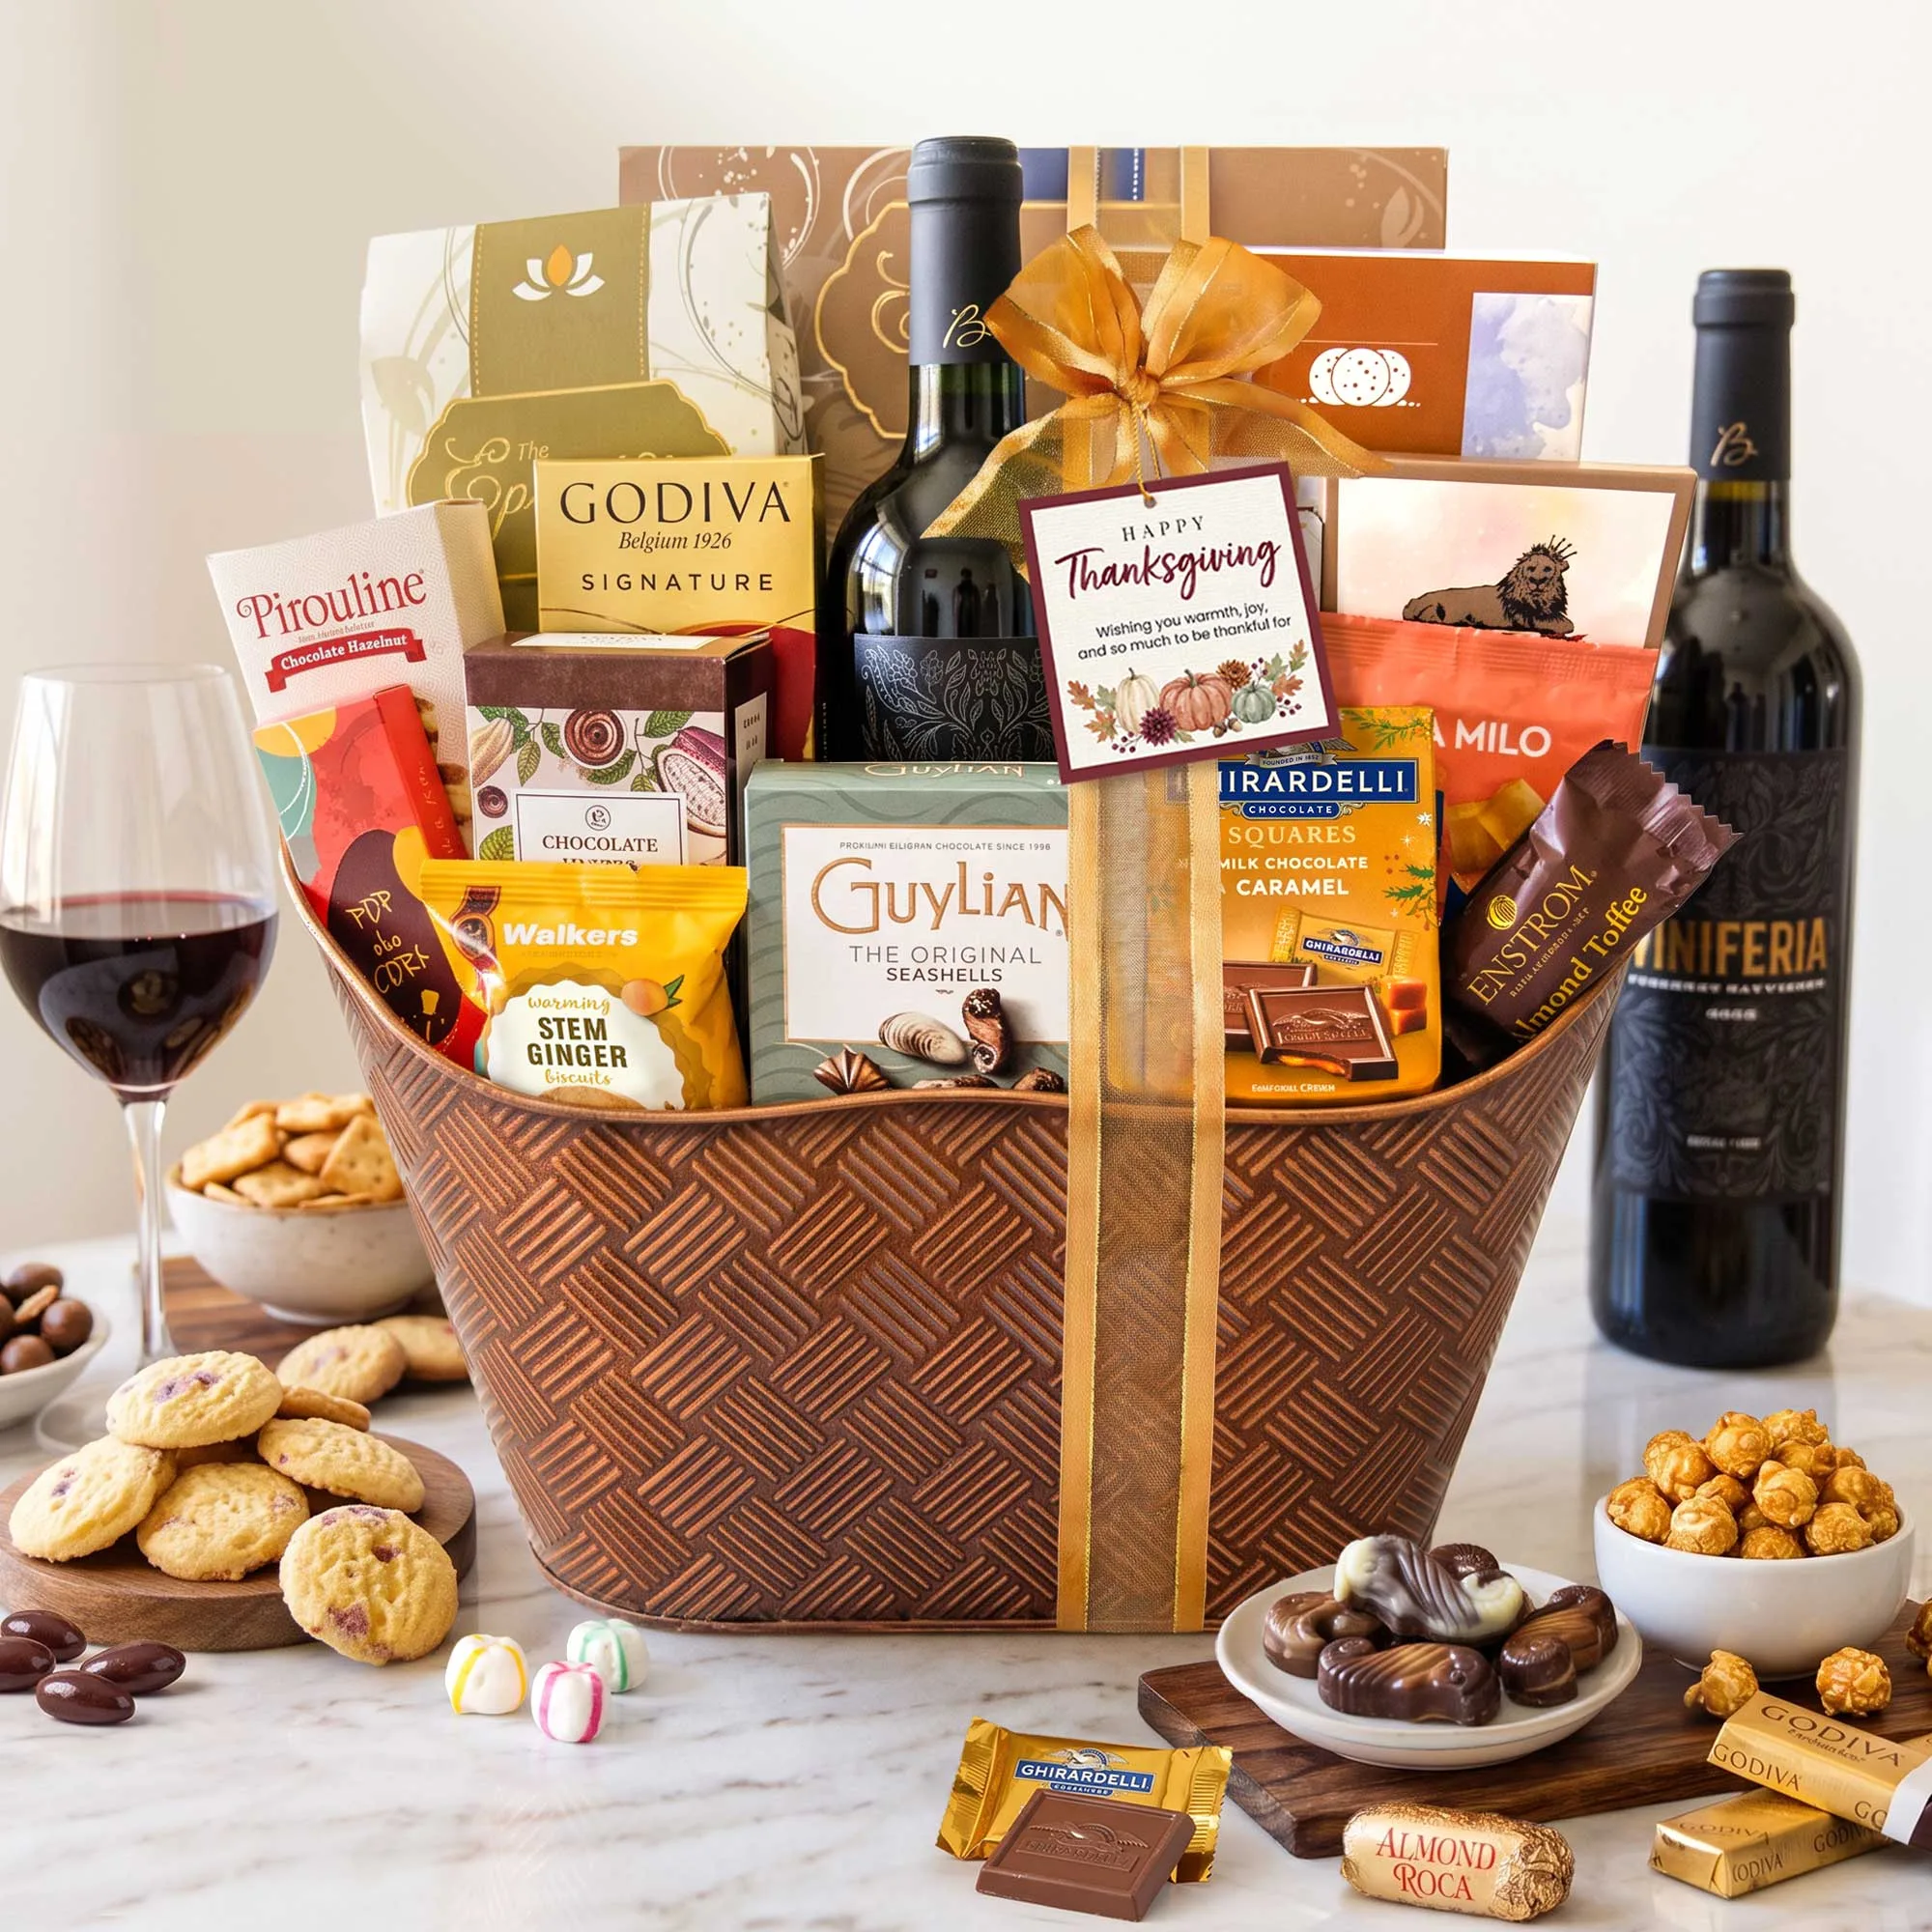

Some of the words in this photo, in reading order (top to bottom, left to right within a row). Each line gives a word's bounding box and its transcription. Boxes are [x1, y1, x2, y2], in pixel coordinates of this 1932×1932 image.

[518, 440, 550, 461] The
[560, 481, 790, 524] GODIVA
[1122, 516, 1204, 542] HAPPY
[618, 531, 688, 554] Belgium
[693, 532, 732, 550] 1926
[582, 574, 773, 590] SIGNATURE
[1055, 540, 1282, 601] Thanksgiving
[236, 572, 427, 639] Pirouline
[1095, 619, 1151, 639] Wishing
[1154, 615, 1181, 633] you
[1183, 606, 1242, 625] warmth,
[1244, 602, 1268, 618] joy,
[1078, 644, 1107, 660] and
[1110, 642, 1127, 655] so
[1130, 631, 1172, 651] much
[1175, 630, 1189, 644] to
[1192, 627, 1210, 640] be
[1213, 618, 1270, 639] thankful
[1272, 615, 1292, 629] for
[280, 645, 346, 669] Chocolate
[347, 633, 408, 654] Hazelnut
[1455, 719, 1551, 757] MILO
[1262, 756, 1294, 767] FOUNDED
[1248, 805, 1333, 815] CHOCOLATE
[542, 835, 659, 853] CHOCOLATE
[935, 841, 994, 852] CHOCOLATE
[996, 842, 1026, 852] SINCE
[1228, 826, 1357, 849] SQUARES
[1220, 857, 1259, 869] MILK
[1264, 856, 1369, 869] CHOCOLATE
[1236, 878, 1350, 896] CARAMEL
[1582, 887, 1648, 957] Toffee
[502, 923, 639, 947] Walkers
[1466, 865, 1594, 1006] ENSTROM
[849, 946, 899, 963] THE
[911, 947, 1042, 964] ORIGINAL
[886, 968, 1003, 982] SEASHELLS
[527, 997, 611, 1016] warming
[538, 1017, 608, 1040] STEM
[526, 1043, 628, 1067] GINGER
[545, 1069, 611, 1085] biscuits
[1761, 1705, 1900, 1767] GODIVA
[1021, 1764, 1150, 1790] GHIRARDELLI
[1713, 1743, 1800, 1791] GODIVA
[1376, 1828, 1495, 1870] ALMOND
[1393, 1862, 1474, 1901] ROCA
